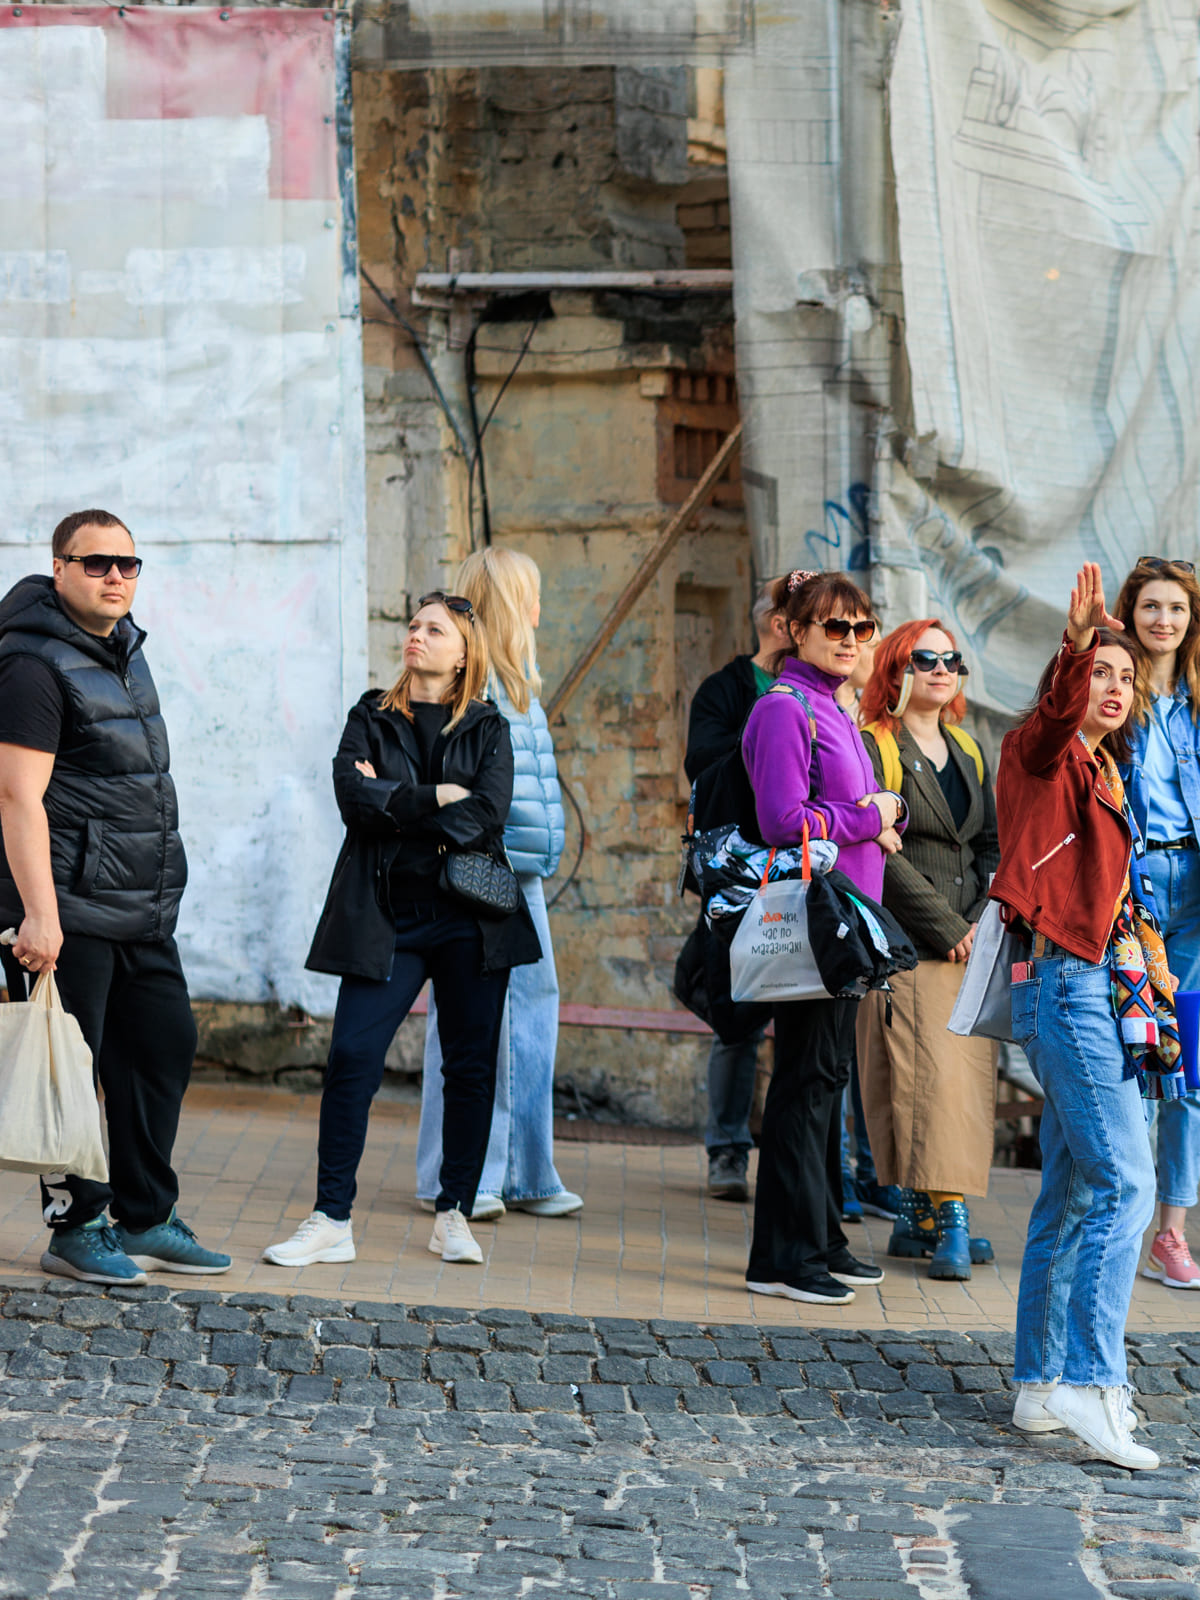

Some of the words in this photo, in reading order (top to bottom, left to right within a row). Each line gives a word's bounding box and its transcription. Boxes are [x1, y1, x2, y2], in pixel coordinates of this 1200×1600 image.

[762, 927, 778, 940] час
[780, 927, 792, 939] по
[751, 940, 802, 956] магазинах!
